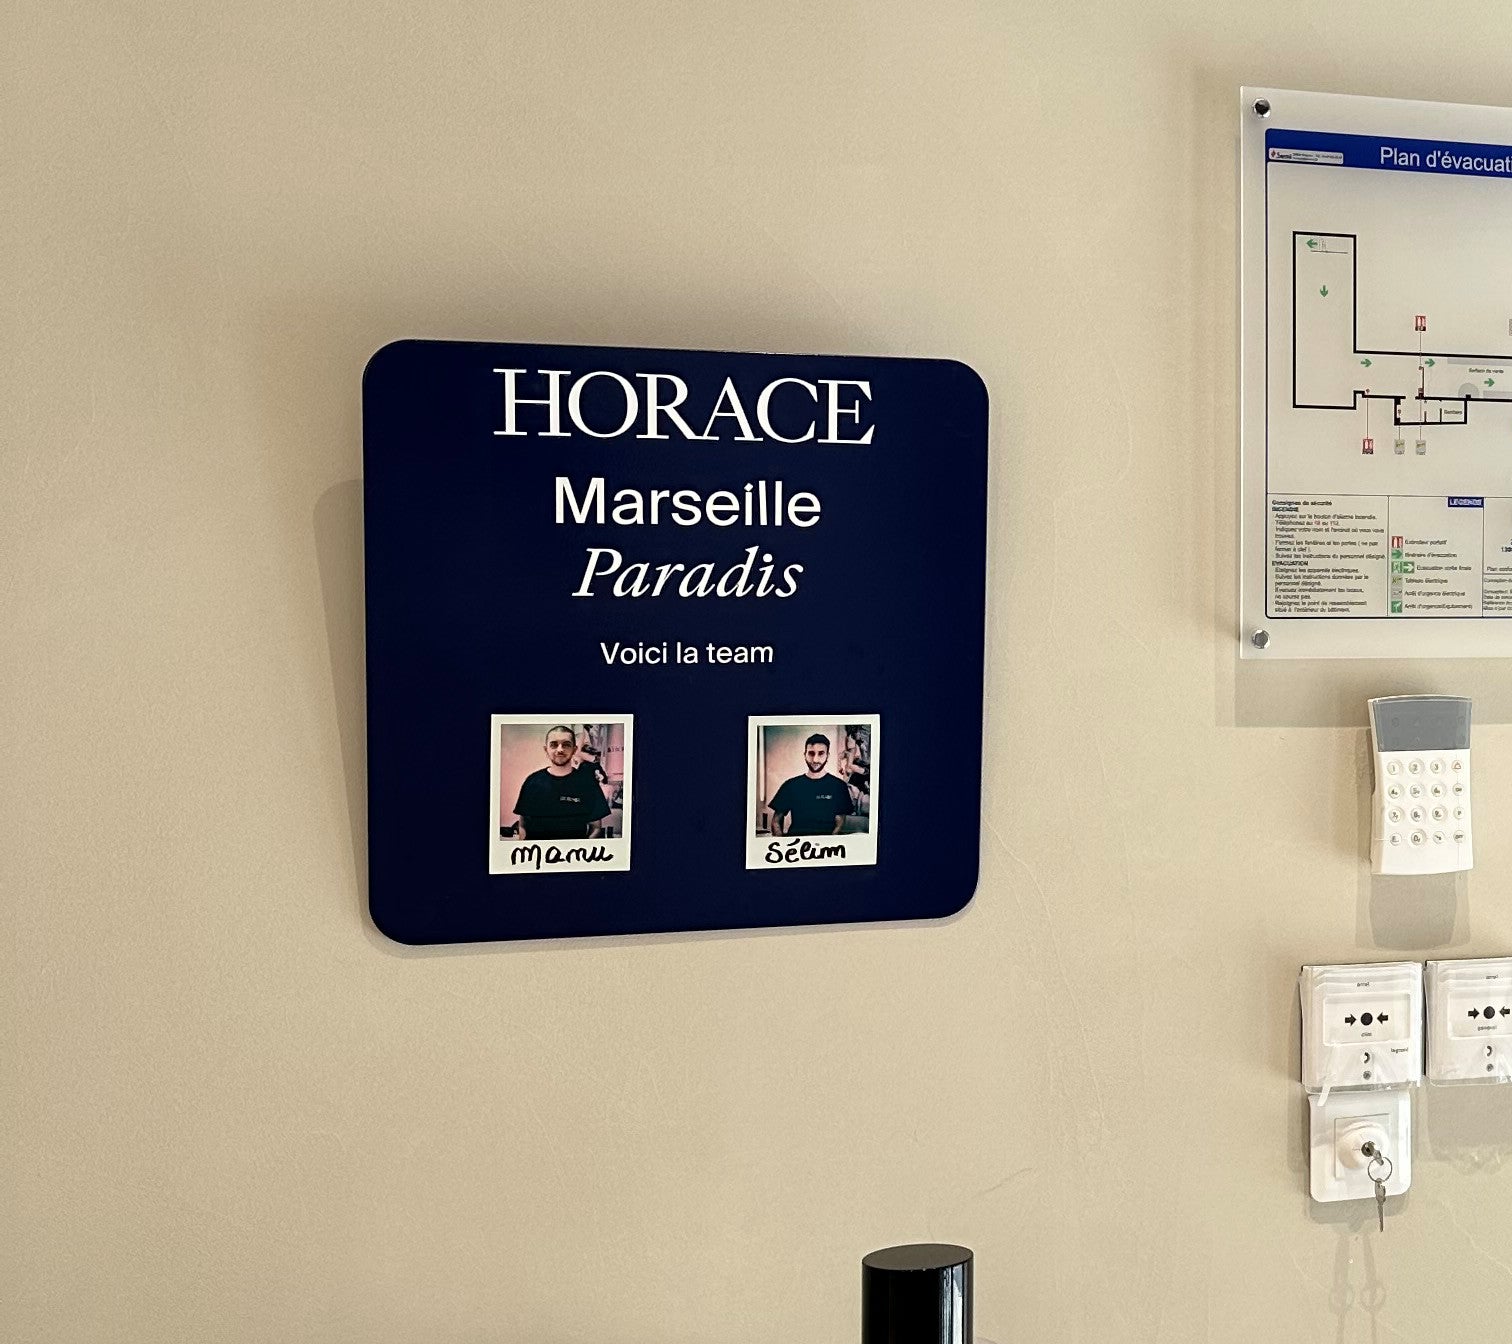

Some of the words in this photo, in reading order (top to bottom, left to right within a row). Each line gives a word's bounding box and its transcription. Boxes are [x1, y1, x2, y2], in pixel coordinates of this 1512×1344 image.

[1380, 147, 1420, 167] Plan
[493, 368, 875, 444] HORACE
[555, 476, 821, 527] Marseille
[572, 545, 804, 598] Paradis
[600, 642, 668, 665] Voici
[676, 641, 698, 663] la
[706, 643, 774, 663] team
[765, 838, 846, 864] Sélim
